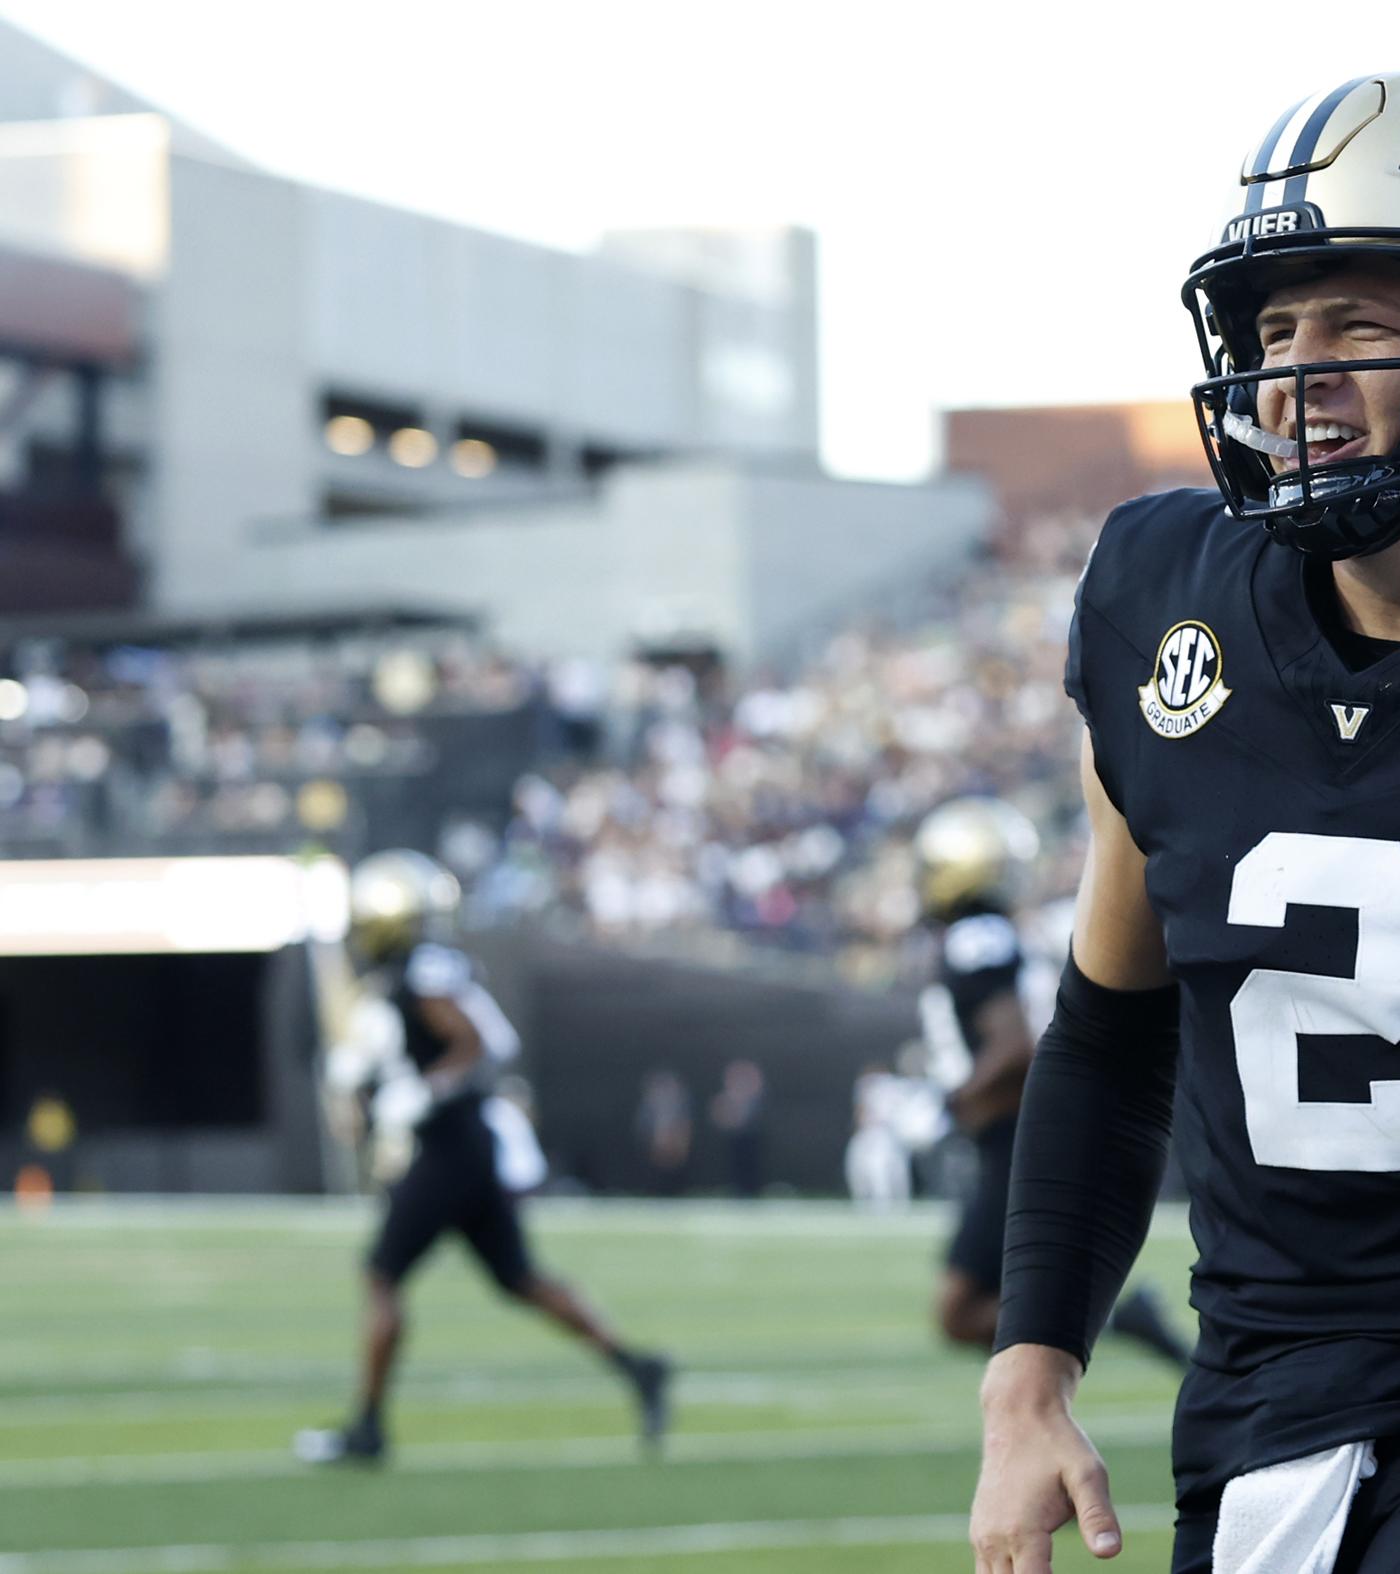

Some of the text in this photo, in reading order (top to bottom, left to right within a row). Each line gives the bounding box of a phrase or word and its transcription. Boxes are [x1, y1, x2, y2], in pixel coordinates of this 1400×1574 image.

[1158, 626, 1216, 708] SEC
[1146, 701, 1212, 735] GRADUATE
[1330, 703, 1370, 740] V
